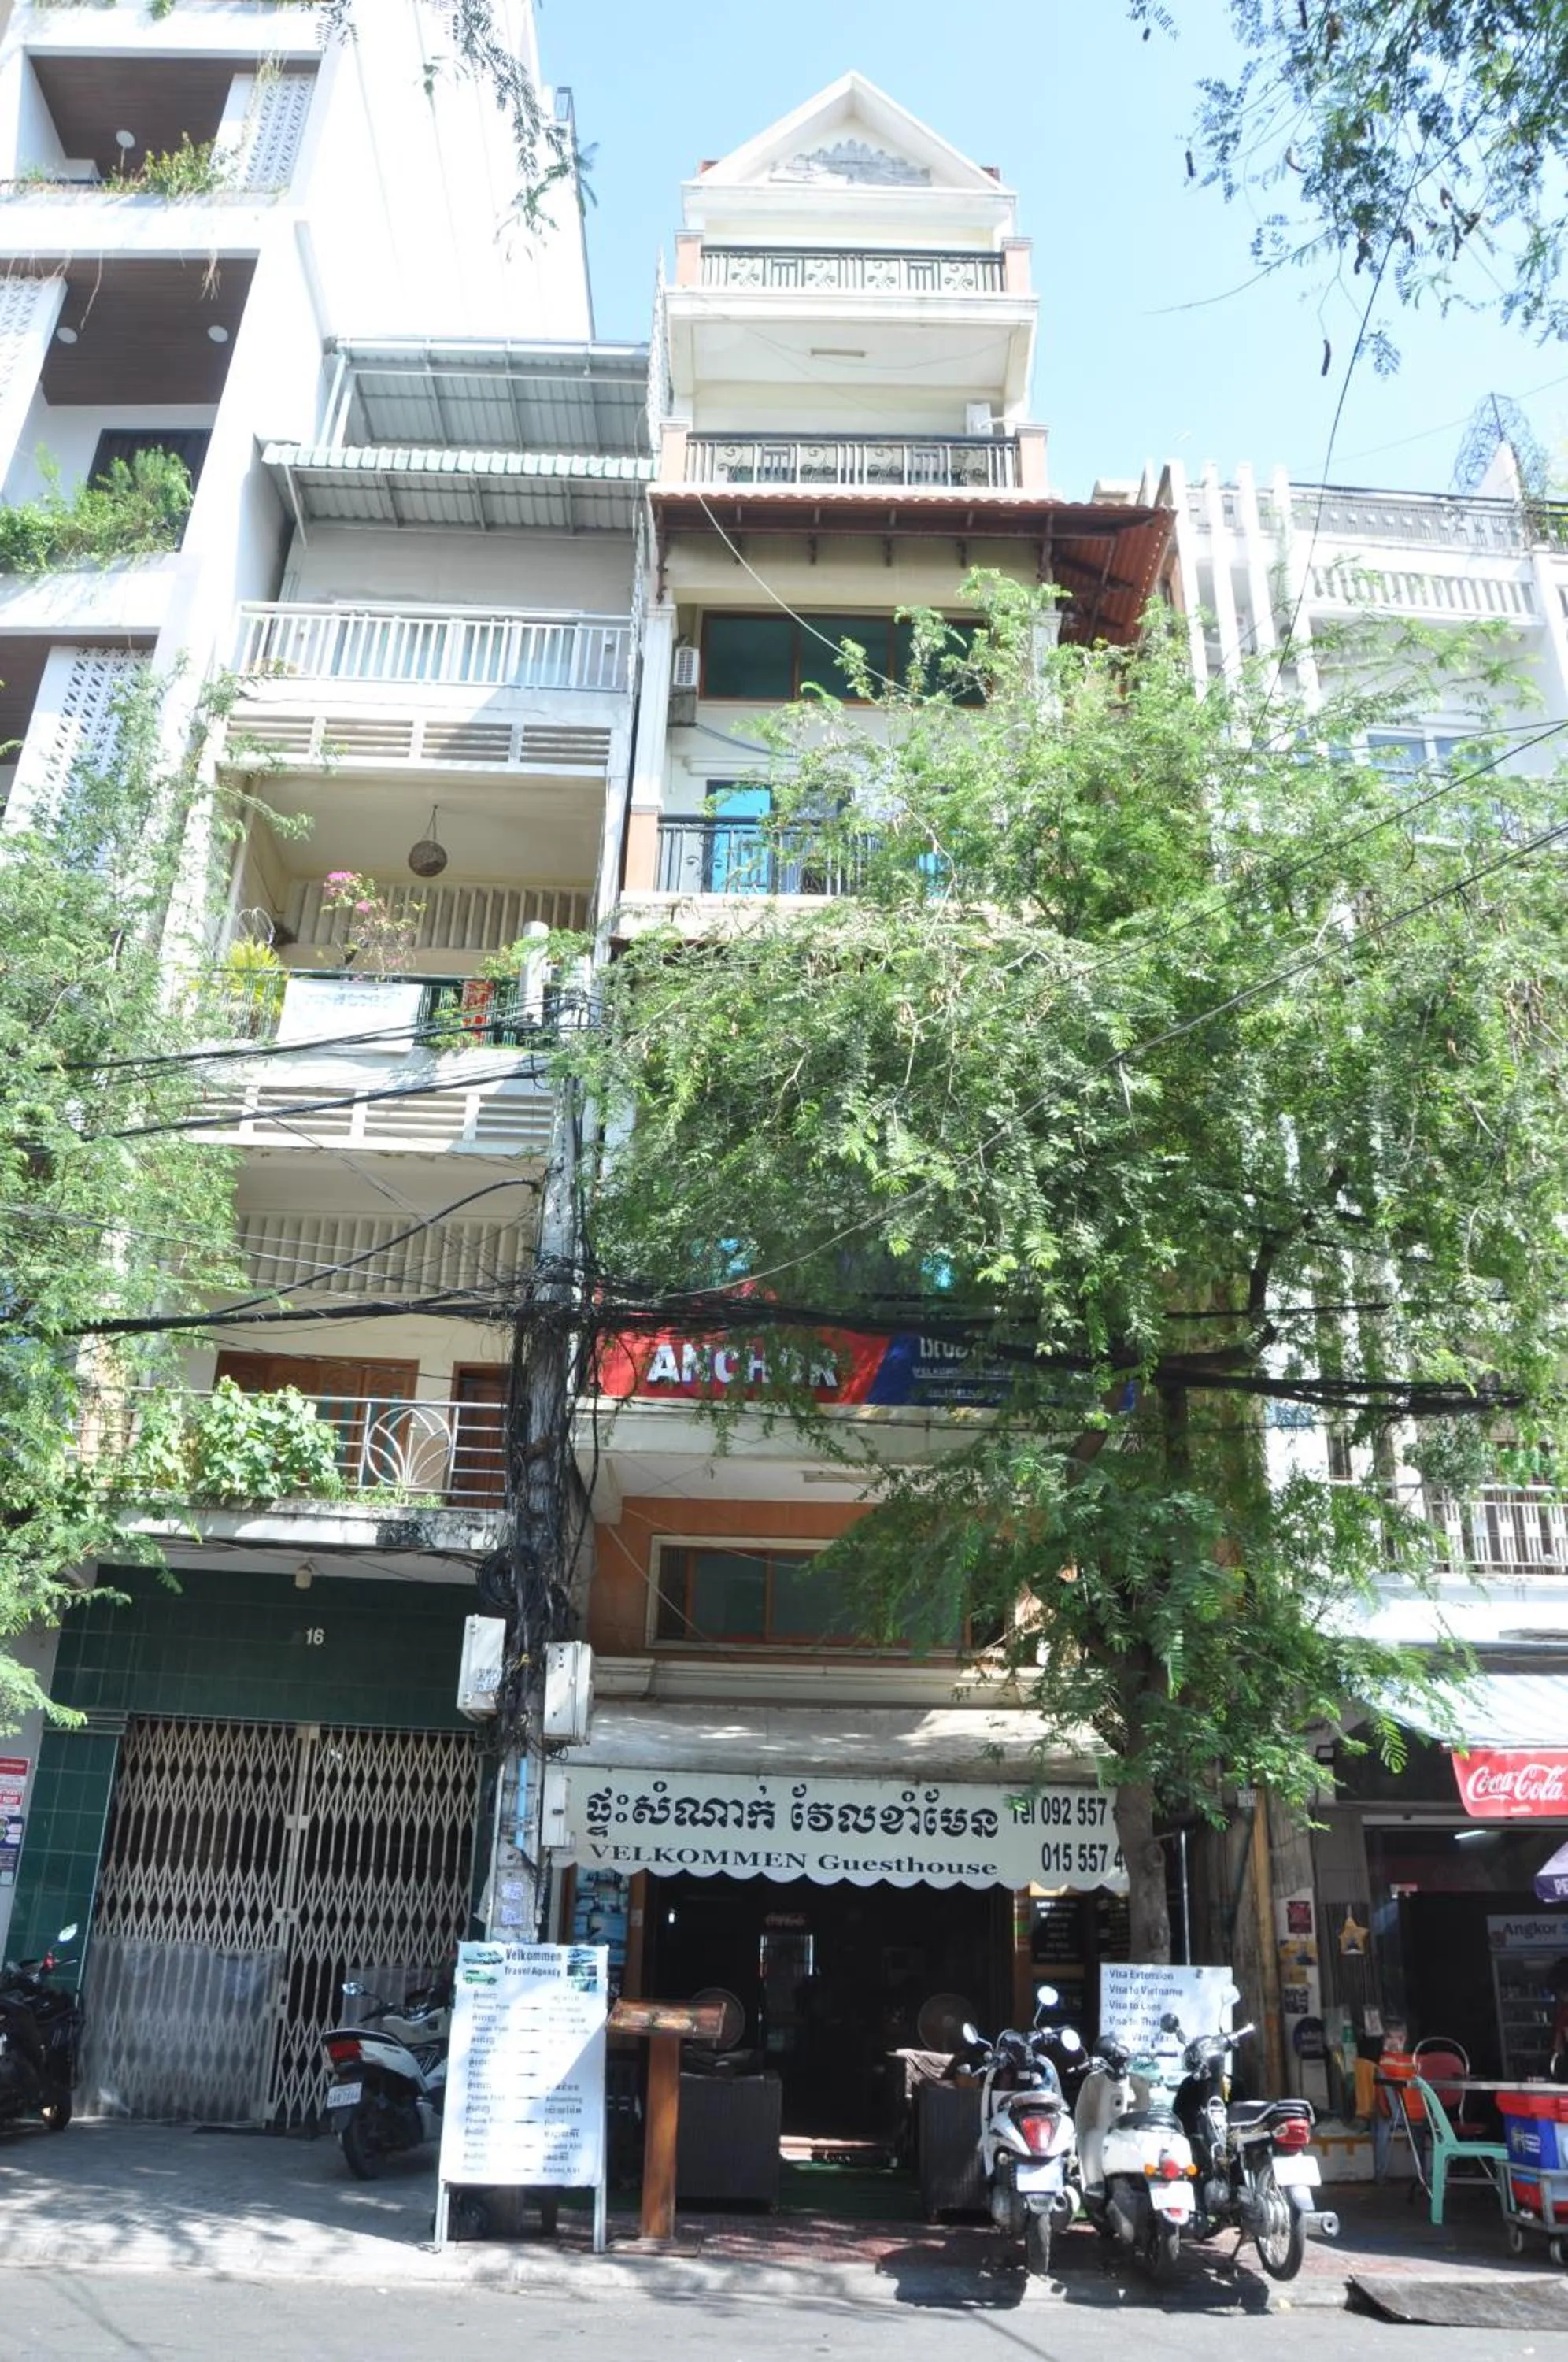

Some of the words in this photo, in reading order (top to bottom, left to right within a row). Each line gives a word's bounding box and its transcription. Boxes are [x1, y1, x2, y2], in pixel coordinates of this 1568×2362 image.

[306, 1627, 325, 1646] 16
[1466, 1764, 1567, 1802] Coca-Cola
[1041, 1797, 1071, 1825] 092
[1078, 1797, 1107, 1825] 557
[590, 1843, 807, 1869] VELKOMMEN
[818, 1854, 998, 1875] Guesthouse
[1041, 1842, 1072, 1871] 015
[1078, 1843, 1108, 1872] 557
[1503, 1922, 1558, 1940] Angkor
[1109, 1969, 1127, 1979] Visa
[1109, 1984, 1127, 1994] Visa
